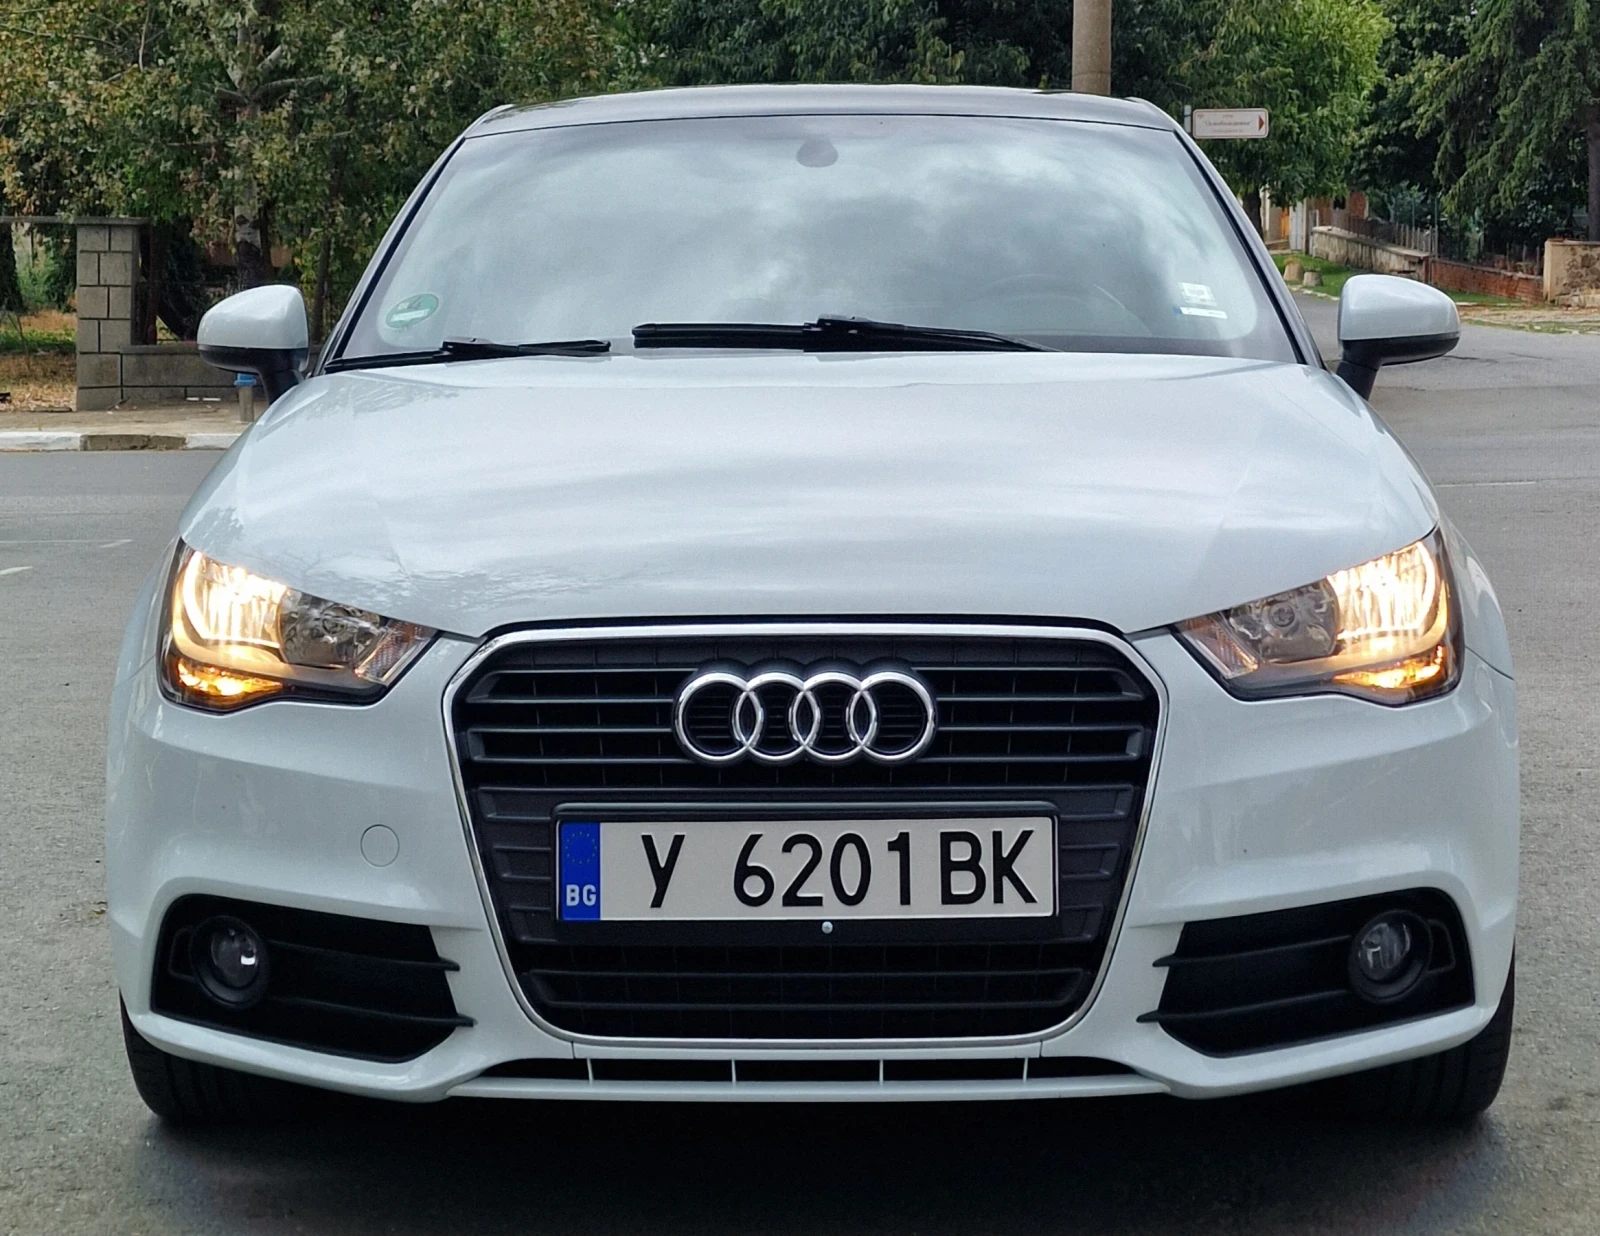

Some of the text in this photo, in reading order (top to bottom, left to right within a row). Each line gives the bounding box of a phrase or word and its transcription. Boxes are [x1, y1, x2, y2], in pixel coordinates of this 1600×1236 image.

[641, 829, 1038, 909] Y 6201 BK
[565, 884, 597, 907] BG
